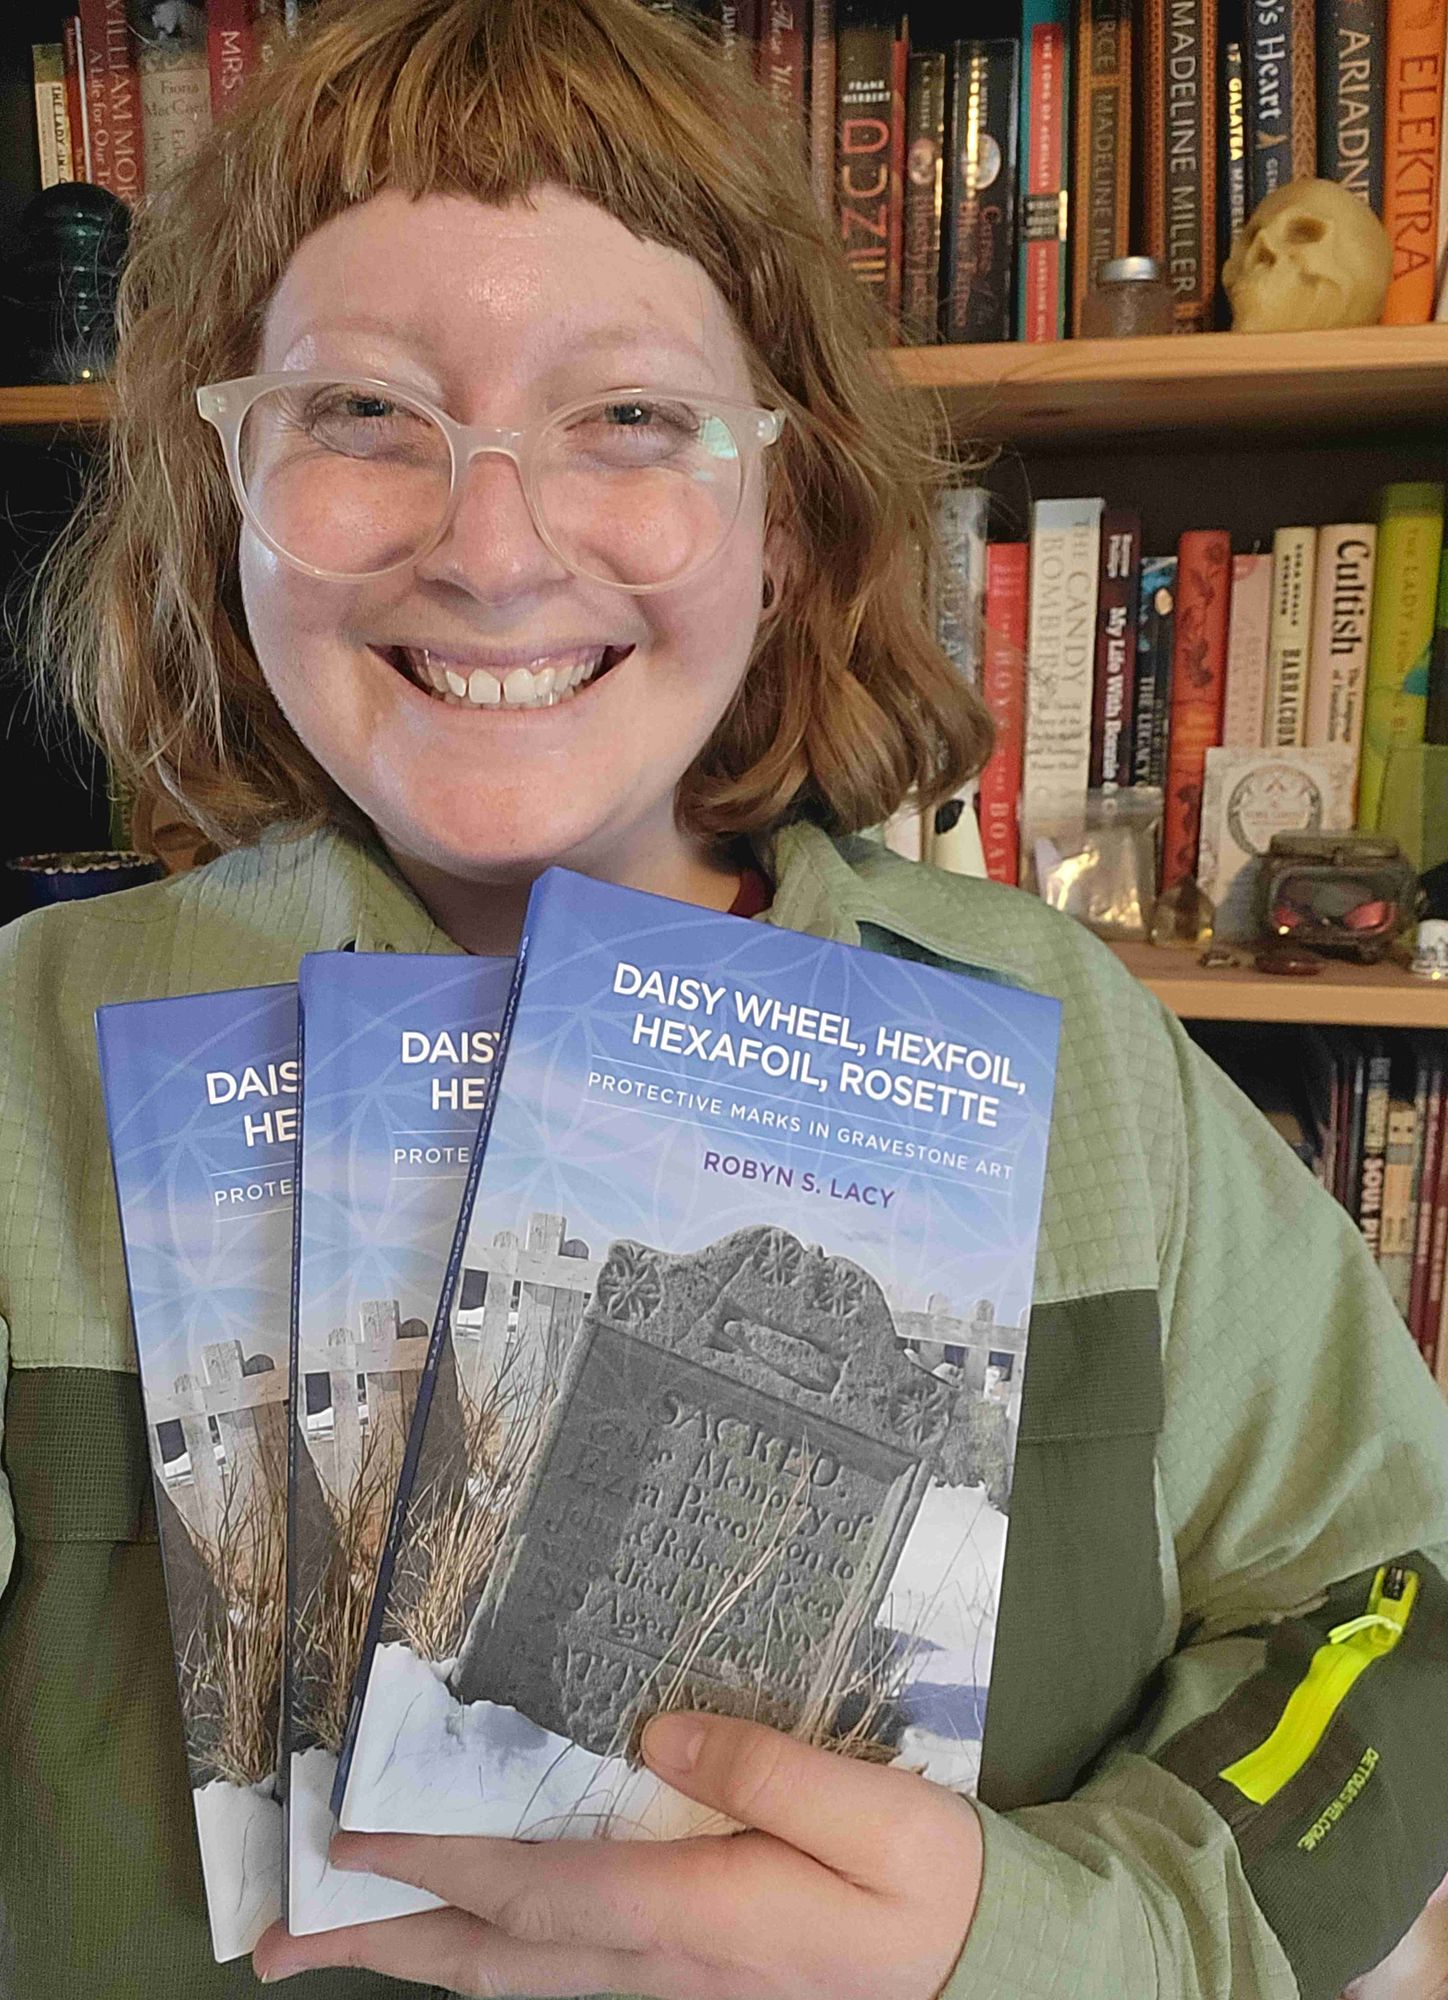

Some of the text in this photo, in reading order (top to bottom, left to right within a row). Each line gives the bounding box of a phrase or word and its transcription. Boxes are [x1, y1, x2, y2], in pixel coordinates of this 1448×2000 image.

[90, 69, 105, 99] Life
[1257, 35, 1285, 121] Heart
[93, 102, 105, 124] for
[95, 129, 109, 162] Our
[1168, 1, 1197, 293] MADELINE MILLER
[1229, 77, 1244, 161] GALATEA
[1091, 94, 1114, 219] MADELINE
[1393, 54, 1439, 282] ELEKTRA
[1062, 518, 1092, 687] THE CANDY
[1107, 607, 1128, 636] My
[1330, 540, 1371, 656] Cultish
[1108, 640, 1126, 673] Life
[1105, 675, 1126, 718] With
[1102, 720, 1124, 780] Bonnie
[988, 801, 1012, 878] BOAT
[401, 1030, 502, 1065] DAIS
[613, 962, 1027, 1095] DAISY WHEEL, HEXFOIL,
[632, 1014, 998, 1128] HEXAFOIL, ROSETTE
[393, 1147, 470, 1165] PROTE
[587, 1071, 1015, 1181] PROTECTIVE MARKS IN GRAVESTONE ART
[214, 1179, 294, 1206] PROTE
[703, 1150, 896, 1210] ROBYN S. LACY
